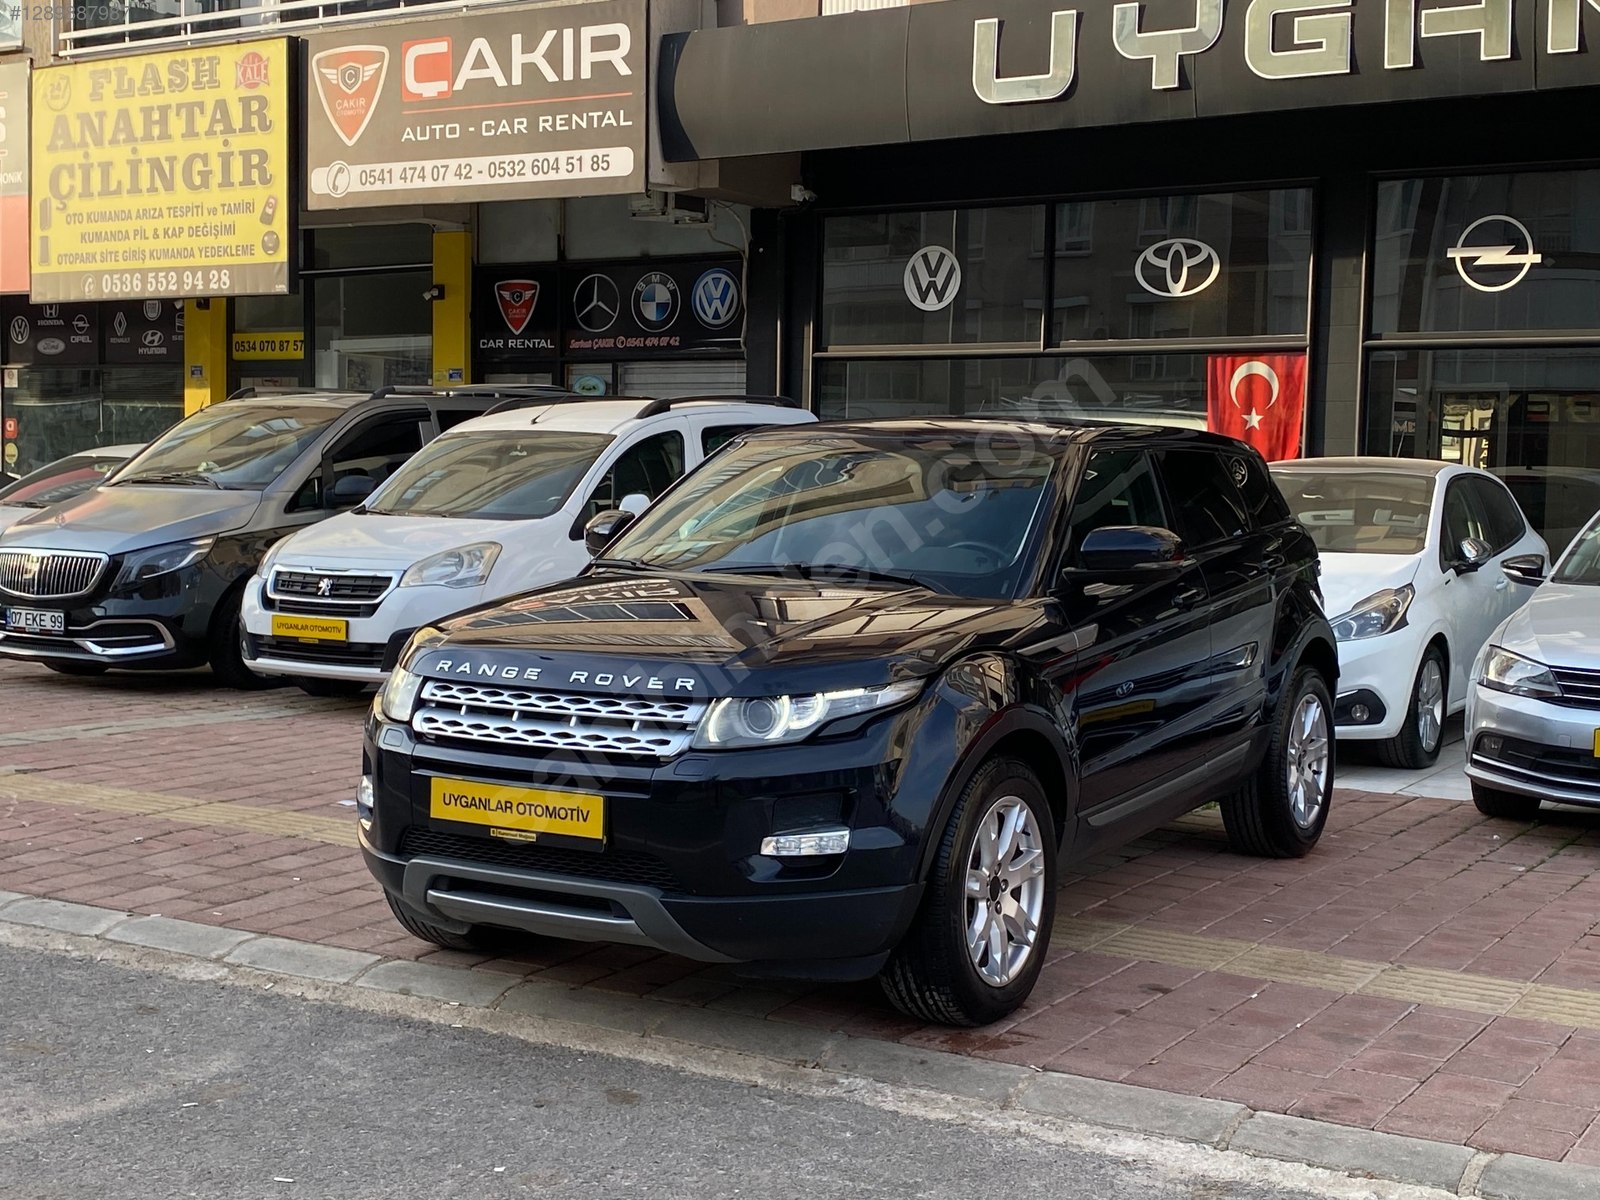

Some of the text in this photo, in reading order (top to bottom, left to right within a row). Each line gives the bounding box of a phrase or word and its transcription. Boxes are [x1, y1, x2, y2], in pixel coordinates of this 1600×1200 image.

[236, 60, 269, 86] KALE
[404, 23, 632, 98] ÇAKIR
[89, 55, 221, 101] FLASH
[46, 94, 273, 152] ANAHTAR
[401, 122, 461, 143] AUTO
[481, 116, 528, 137] CAR
[538, 109, 633, 133] RENTAL
[49, 138, 273, 211] ÇİLİNGİR
[359, 167, 394, 186] 0541
[399, 165, 426, 183] 474
[430, 163, 449, 182] 07
[454, 162, 473, 181] 42
[488, 159, 526, 178] 0532
[531, 157, 560, 175] 604
[565, 155, 583, 174] 51
[590, 153, 611, 172] 85
[65, 199, 255, 225] OTO KUMANDA ARIZA TESPİTİ ve TAMİRİ
[80, 222, 236, 244] KUMANDA PİL & KAP DEĞİŞİMİ
[57, 243, 255, 266] OTOPARK SİTE GİRİŞ KUMANDA YEDEKLEME
[102, 269, 230, 293] 0536 552 94 28
[70, 335, 93, 343] OPEL
[138, 347, 167, 355] HYUNDAI
[234, 339, 304, 352] 0534 070 87 57
[480, 337, 555, 349] CAR RENTAL
[11, 611, 22, 625] 07
[25, 612, 47, 628] EKE
[50, 614, 63, 629] 99
[276, 621, 342, 634] UYGANLAR OTOMOTİV
[435, 660, 696, 691] RANGE ROVER
[442, 793, 591, 824] UYGANLAR OTOMOTİV
